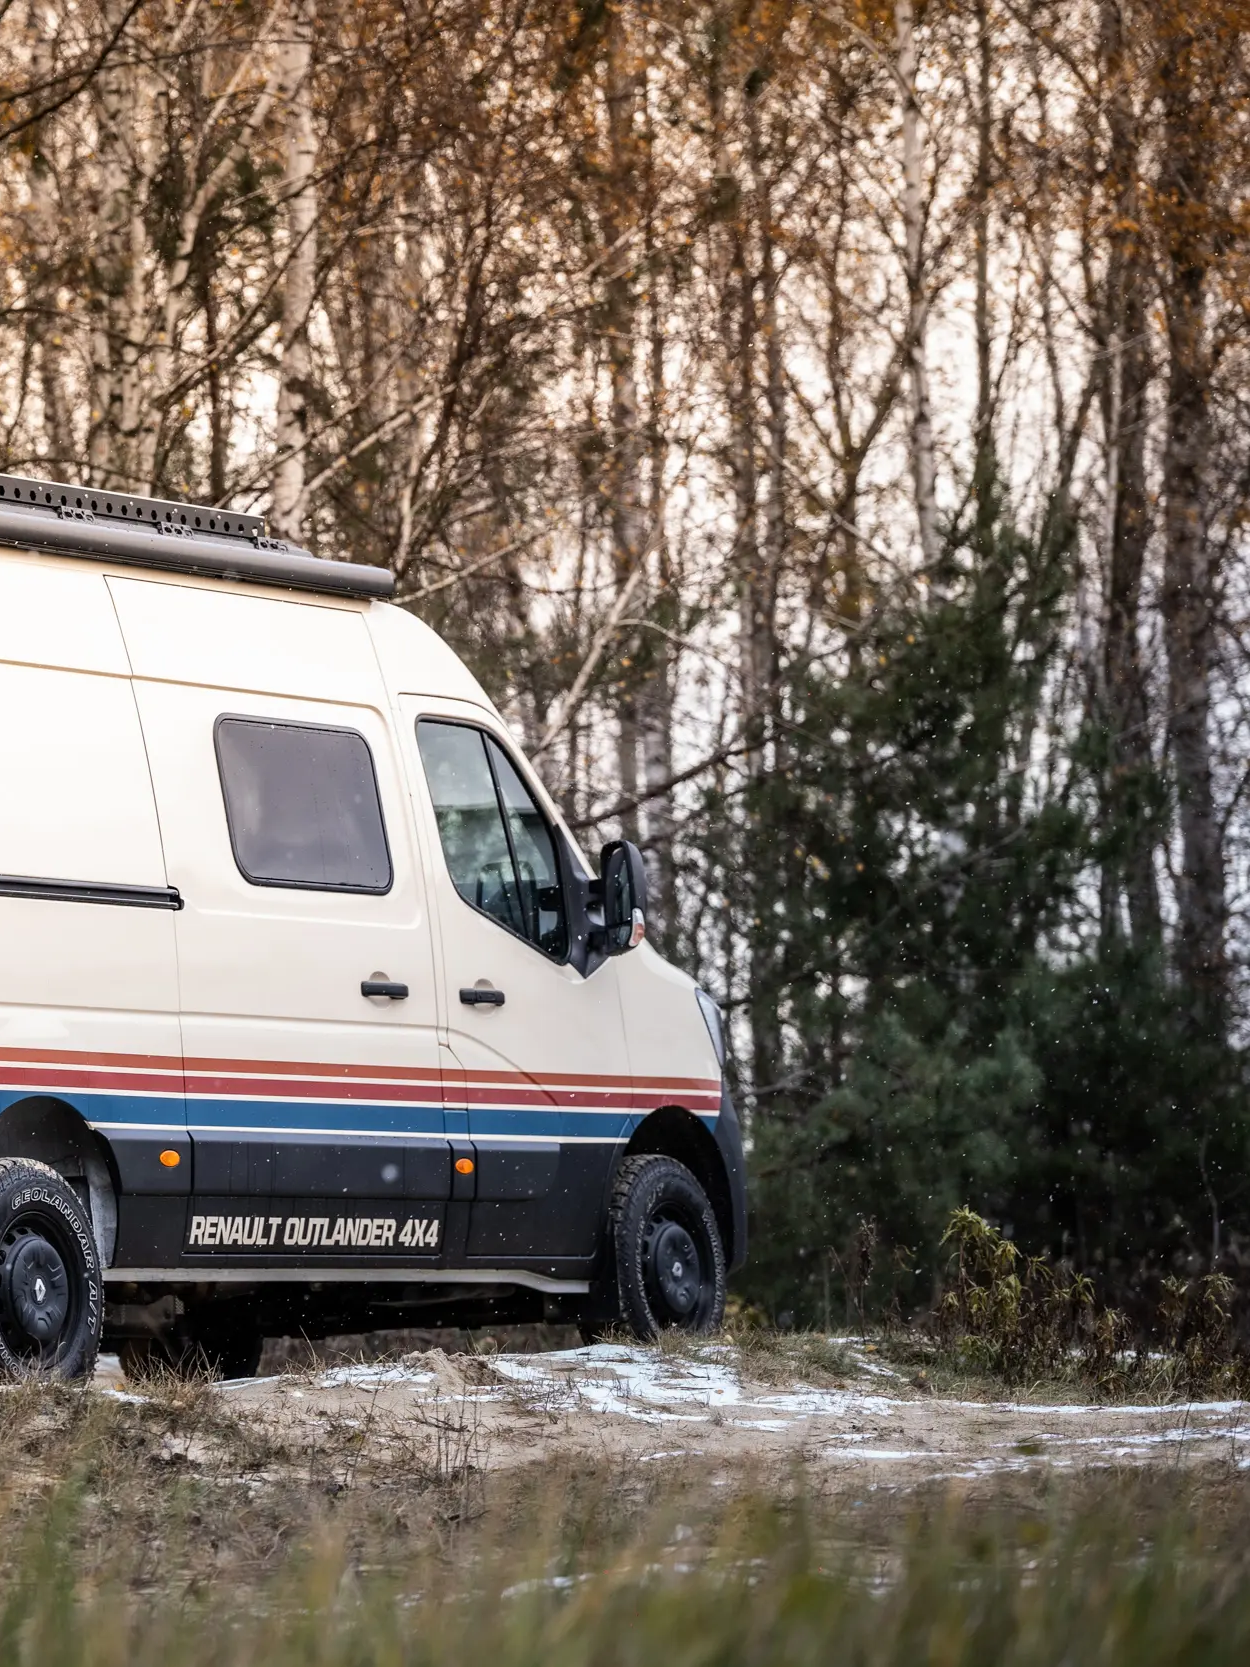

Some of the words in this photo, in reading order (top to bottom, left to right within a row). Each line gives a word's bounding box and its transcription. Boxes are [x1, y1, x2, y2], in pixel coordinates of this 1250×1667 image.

[11, 1187, 95, 1269] GEOLANDAR
[87, 1280, 98, 1335] A/T
[188, 1215, 282, 1245] RENAULT
[283, 1217, 397, 1246] OUTLANDER
[398, 1219, 440, 1247] 4X4
